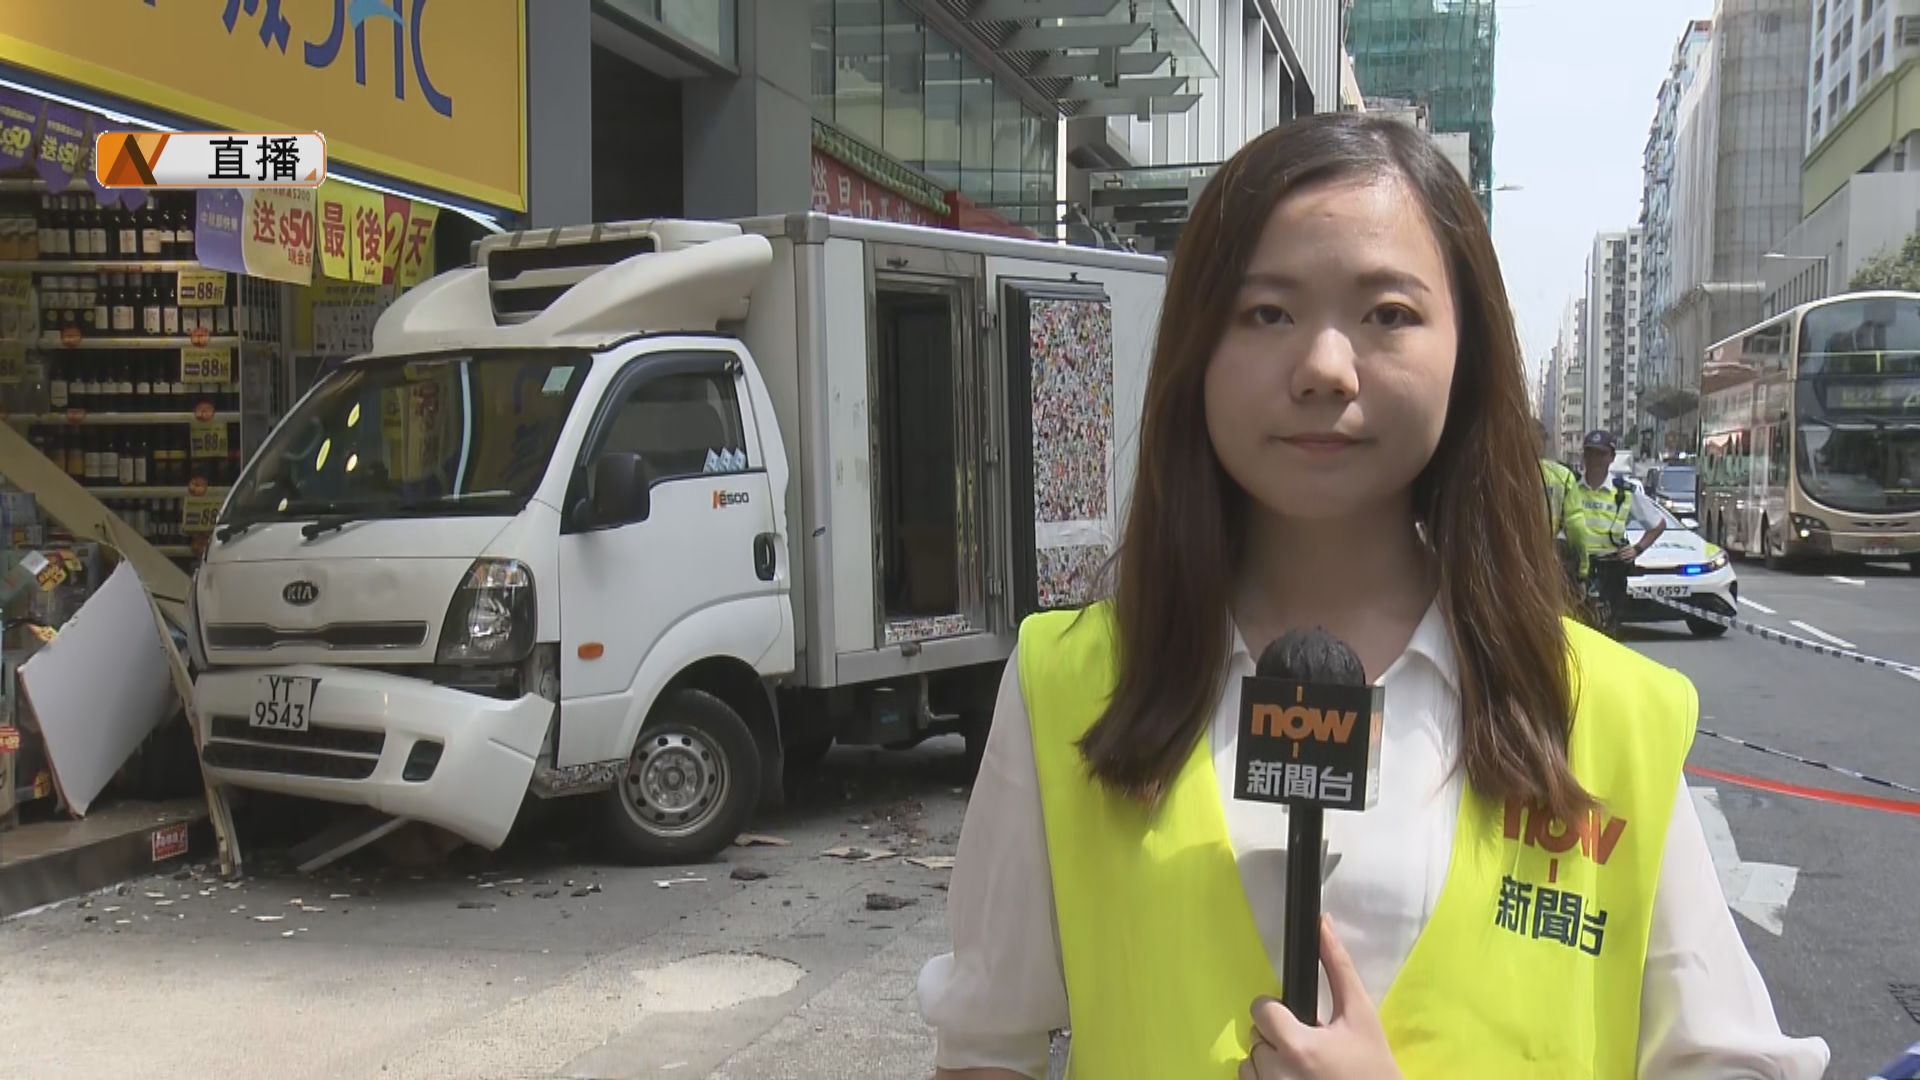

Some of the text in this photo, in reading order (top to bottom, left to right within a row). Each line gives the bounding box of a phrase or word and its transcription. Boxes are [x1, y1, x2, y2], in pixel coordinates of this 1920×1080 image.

[253, 199, 313, 249] 送 $50
[287, 583, 314, 600] KIA
[1656, 585, 1689, 597] 6597
[269, 676, 294, 703] YT
[255, 701, 304, 729] 9543
[1250, 703, 1358, 743] now
[1246, 759, 1353, 802] 新聞台
[1503, 796, 1628, 865] now
[1494, 873, 1609, 957] 新聞台
